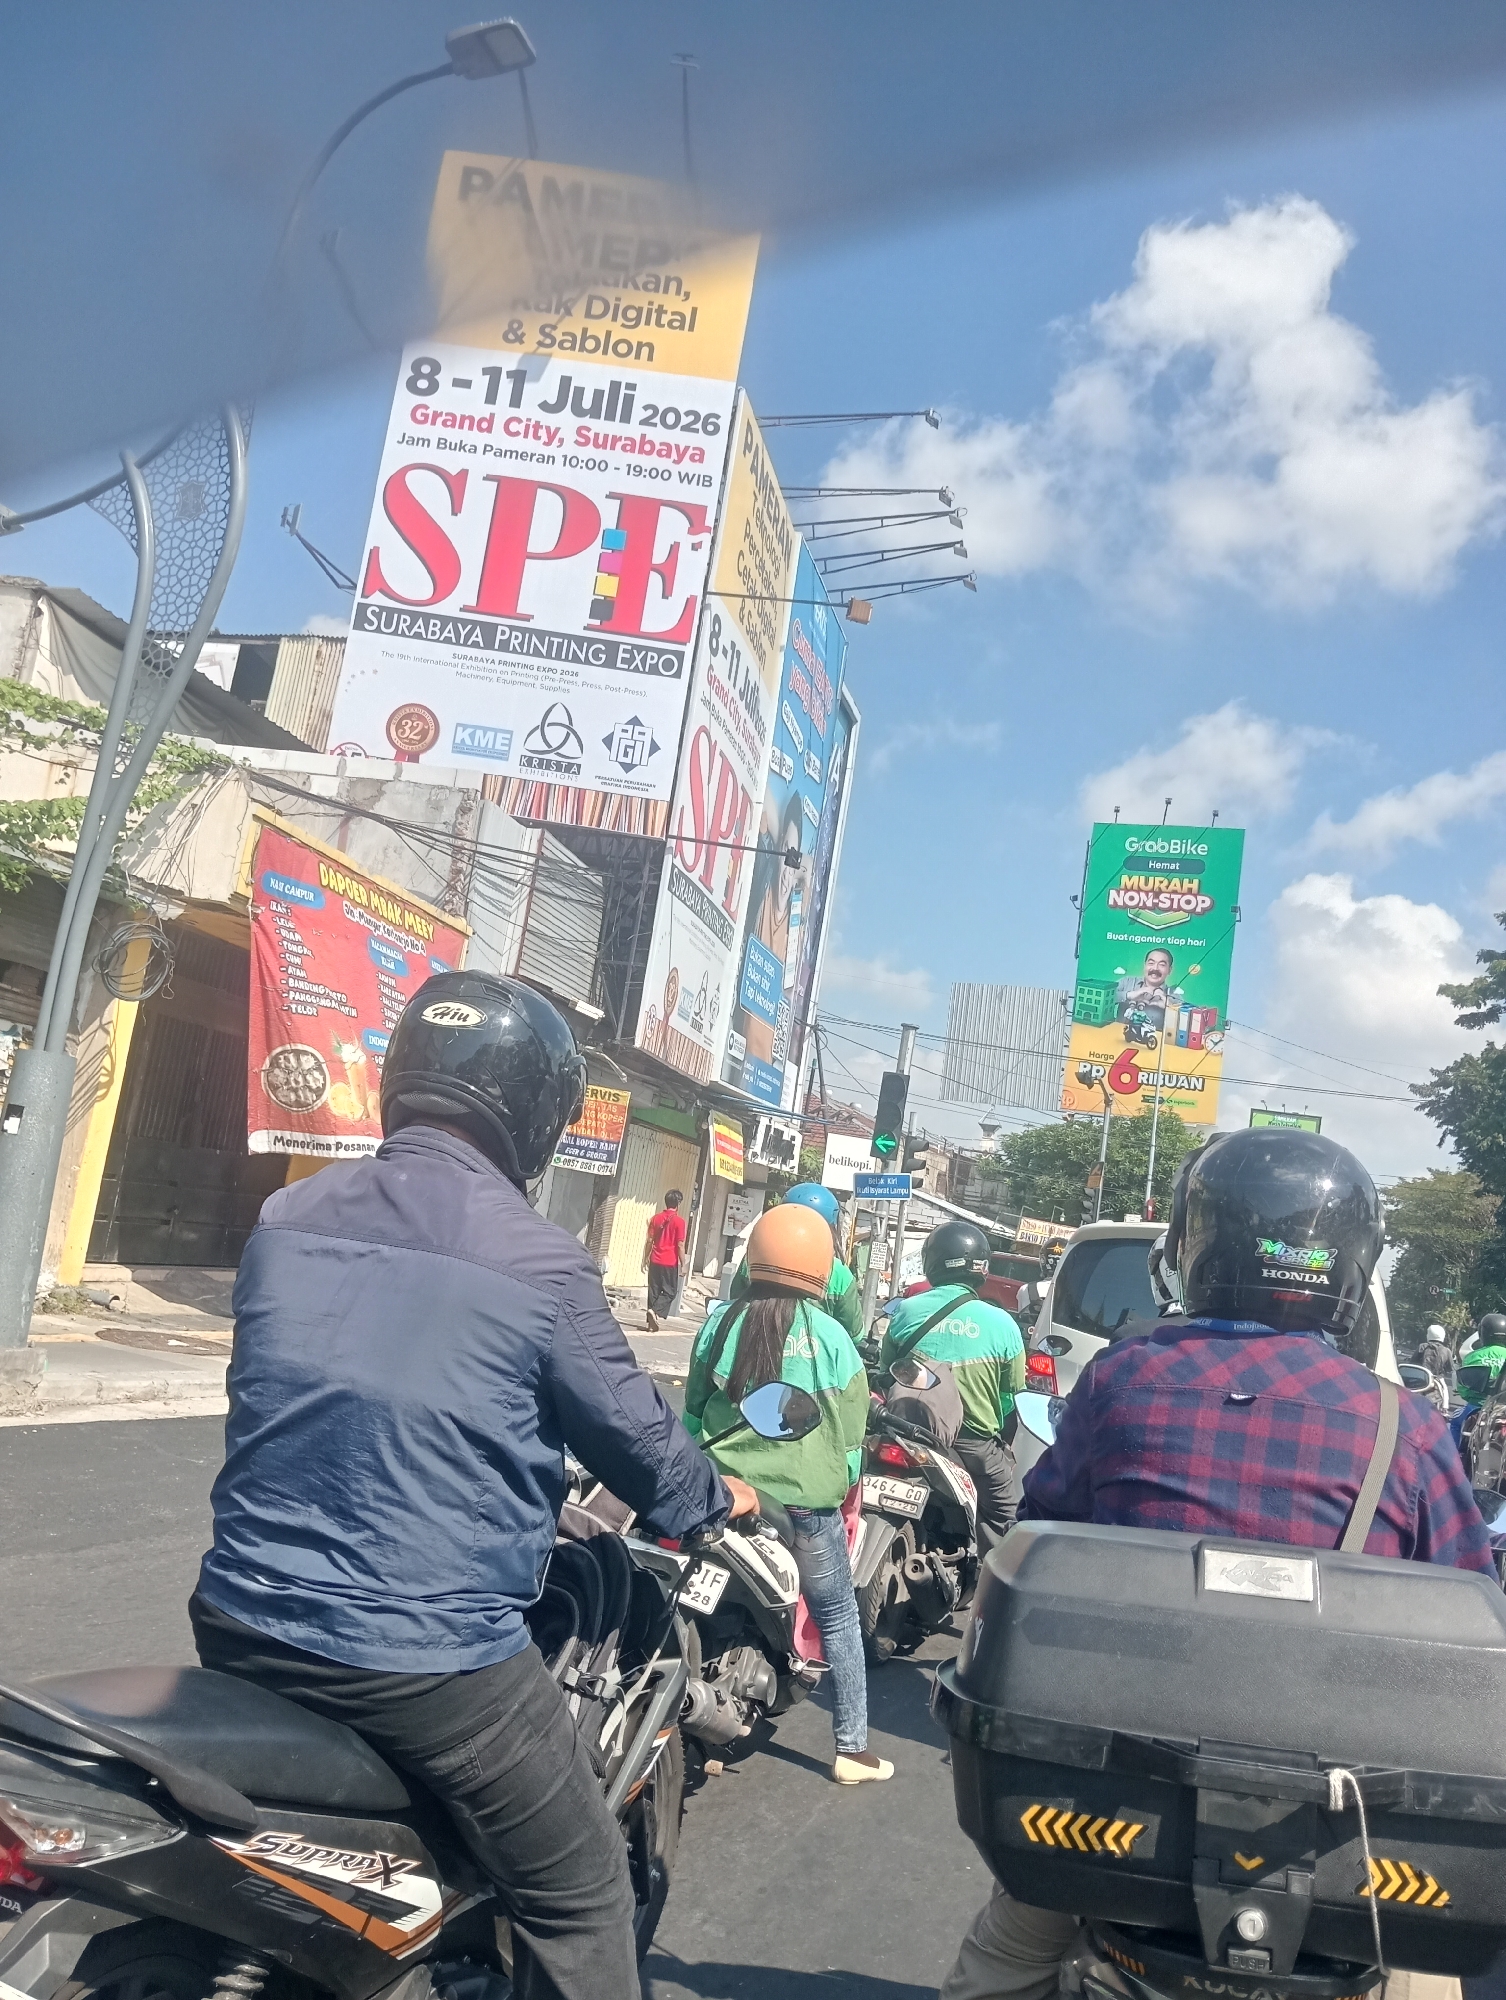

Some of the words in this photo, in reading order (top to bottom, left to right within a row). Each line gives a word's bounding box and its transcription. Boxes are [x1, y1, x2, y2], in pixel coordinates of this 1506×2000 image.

[584, 295, 698, 333] Digital
[502, 319, 526, 345] &
[536, 324, 656, 362] Sablon
[537, 374, 638, 425] Juli
[639, 403, 722, 437] 2026
[410, 403, 496, 435] Grand
[503, 416, 565, 449] City,
[573, 425, 706, 466] Surabaya
[397, 432, 431, 448] Jam
[436, 437, 478, 455] Buka
[482, 443, 556, 467] Pameran
[561, 454, 609, 473] 10:00
[625, 463, 672, 482] 19:00
[677, 470, 714, 488] WIB
[743, 418, 793, 573] PAMERAN
[361, 462, 710, 645] SPE
[363, 606, 485, 648] SURABAYA
[493, 625, 607, 667] PRINTING
[615, 644, 680, 677] EXPO
[381, 650, 395, 660] The
[397, 653, 412, 661] 19th
[413, 655, 460, 670] International
[461, 663, 498, 675] Exhibition
[510, 670, 539, 681] Printing
[451, 652, 497, 666] SURABAYA
[498, 659, 535, 671] PRINTING
[536, 663, 558, 675] EXPO
[560, 669, 580, 678] 2026
[455, 670, 494, 683] Machinery,
[496, 676, 538, 690] Equipment,
[539, 683, 571, 695] Supplies
[454, 725, 512, 751] KME
[520, 755, 580, 775] KRISTA
[1124, 836, 1209, 856] GrabBike
[1148, 860, 1181, 871] Hemat
[284, 884, 315, 902] CAMPUR
[319, 862, 369, 908] DAPOER
[369, 889, 403, 926] MBAK
[1119, 874, 1200, 894] MURAH
[1107, 889, 1212, 913] NON-STOP
[1106, 931, 1129, 941] Buat
[1129, 934, 1166, 944] ngantor
[1167, 936, 1186, 947] tiap
[1187, 937, 1206, 947] hari
[288, 976, 327, 995] BANDENG
[1088, 1050, 1115, 1062] Harga
[1107, 1047, 1143, 1095] 6
[1137, 1071, 1205, 1092] RIBUAN
[585, 1087, 621, 1103] ERVIS
[597, 1111, 625, 1124] KOPER
[602, 1103, 618, 1113] TAS
[273, 1135, 333, 1151] Menerima
[335, 1141, 376, 1152] Pesanan
[828, 1154, 872, 1172] belikopi.
[868, 1176, 885, 1185] Belok
[887, 1176, 898, 1186] Kiri
[890, 1187, 909, 1196] Lampu
[1261, 1268, 1330, 1285] HONDA
[929, 1316, 981, 1339] rab
[782, 1327, 821, 1360] ab
[1232, 1955, 1266, 1971] PUSH
